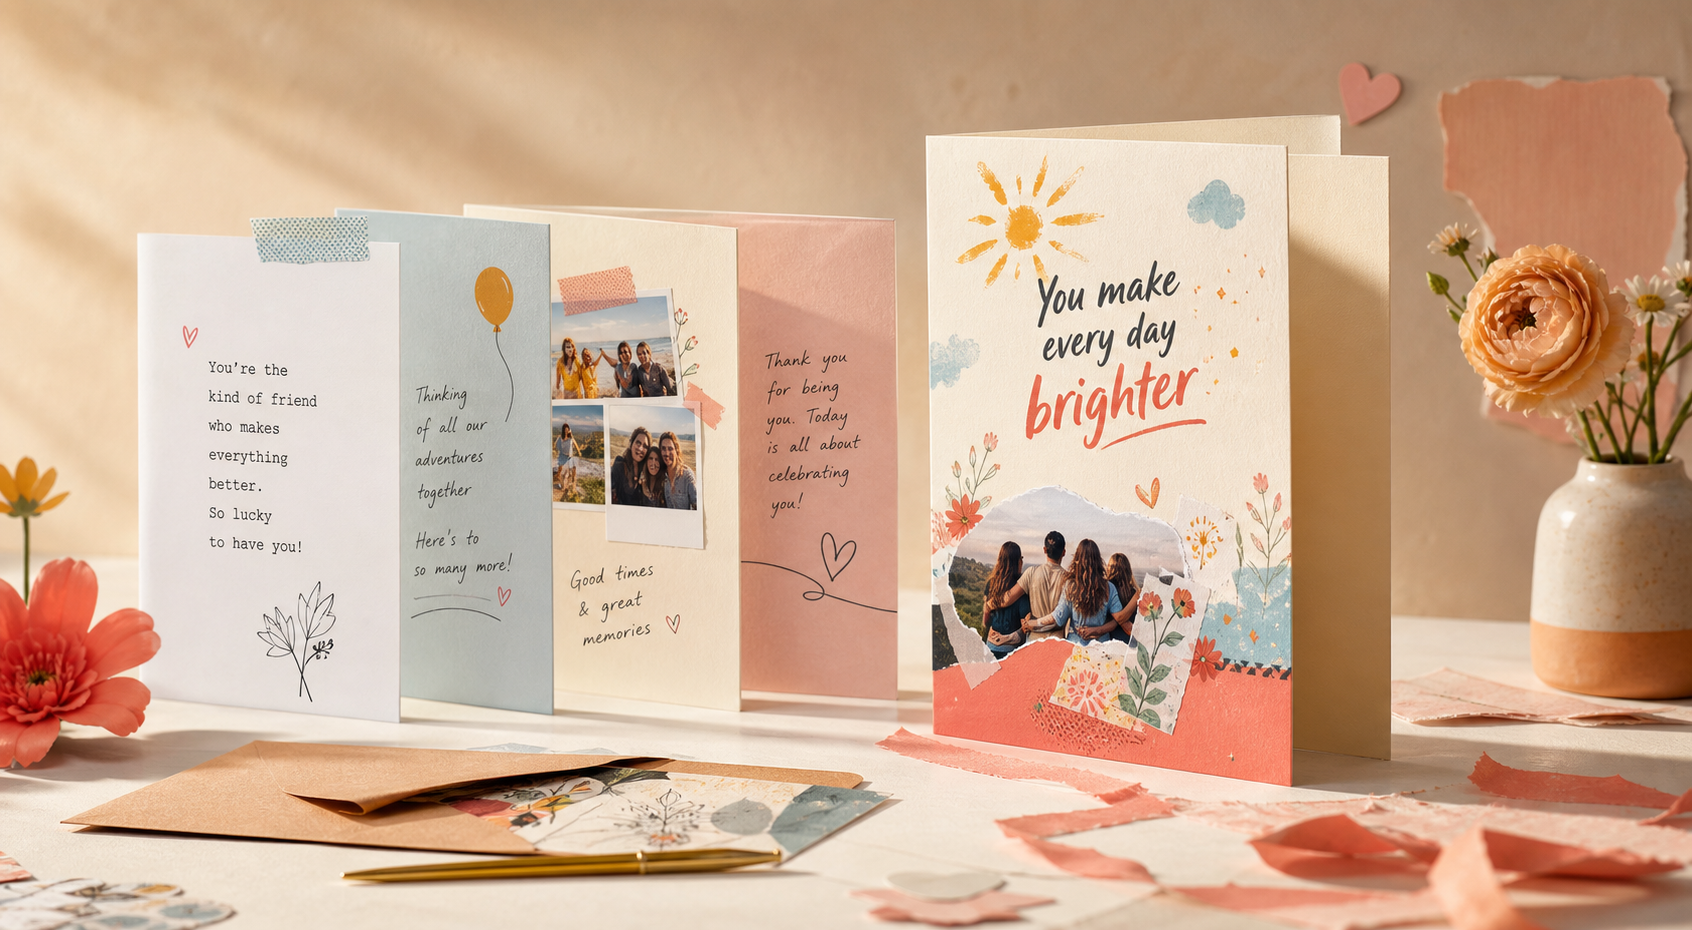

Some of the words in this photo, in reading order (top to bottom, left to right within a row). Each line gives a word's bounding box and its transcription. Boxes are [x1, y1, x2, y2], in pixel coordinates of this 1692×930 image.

[1037, 274, 1085, 328] You
[1097, 260, 1181, 308] make
[1042, 329, 1115, 368] every
[1126, 311, 1177, 359] day
[208, 361, 256, 375] You're
[264, 363, 288, 377] the
[764, 349, 811, 370] Thank
[821, 354, 848, 374] you
[208, 389, 240, 404] kind
[247, 391, 263, 405] of
[271, 392, 318, 408] friend
[415, 384, 467, 410] Thinking
[767, 380, 791, 405] for
[801, 378, 839, 402] being
[1025, 360, 1200, 450] brighter
[208, 418, 233, 432] who
[239, 420, 280, 435] makes
[416, 417, 432, 443] of
[439, 415, 458, 434] all
[465, 421, 488, 432] our
[765, 416, 795, 436] you.
[806, 406, 848, 431] Today
[767, 441, 779, 454] is
[789, 435, 811, 453] all
[819, 434, 861, 451] about
[208, 450, 288, 468] everything
[415, 449, 484, 467] adventures
[208, 476, 262, 492] better.
[768, 464, 850, 488] celebrating
[417, 481, 473, 509] together
[770, 491, 804, 519] you!
[209, 506, 225, 519] So
[233, 507, 272, 525] lucky
[209, 536, 225, 548] to
[232, 536, 264, 551] have
[272, 540, 302, 555] you!
[415, 528, 456, 550] Here's
[466, 529, 480, 546] to
[413, 565, 426, 577] so
[434, 564, 467, 585] many
[475, 552, 513, 572] more!
[570, 567, 605, 591] Good
[615, 564, 654, 581] times
[578, 600, 589, 617] &
[600, 590, 643, 624] great
[582, 619, 651, 647] memories
